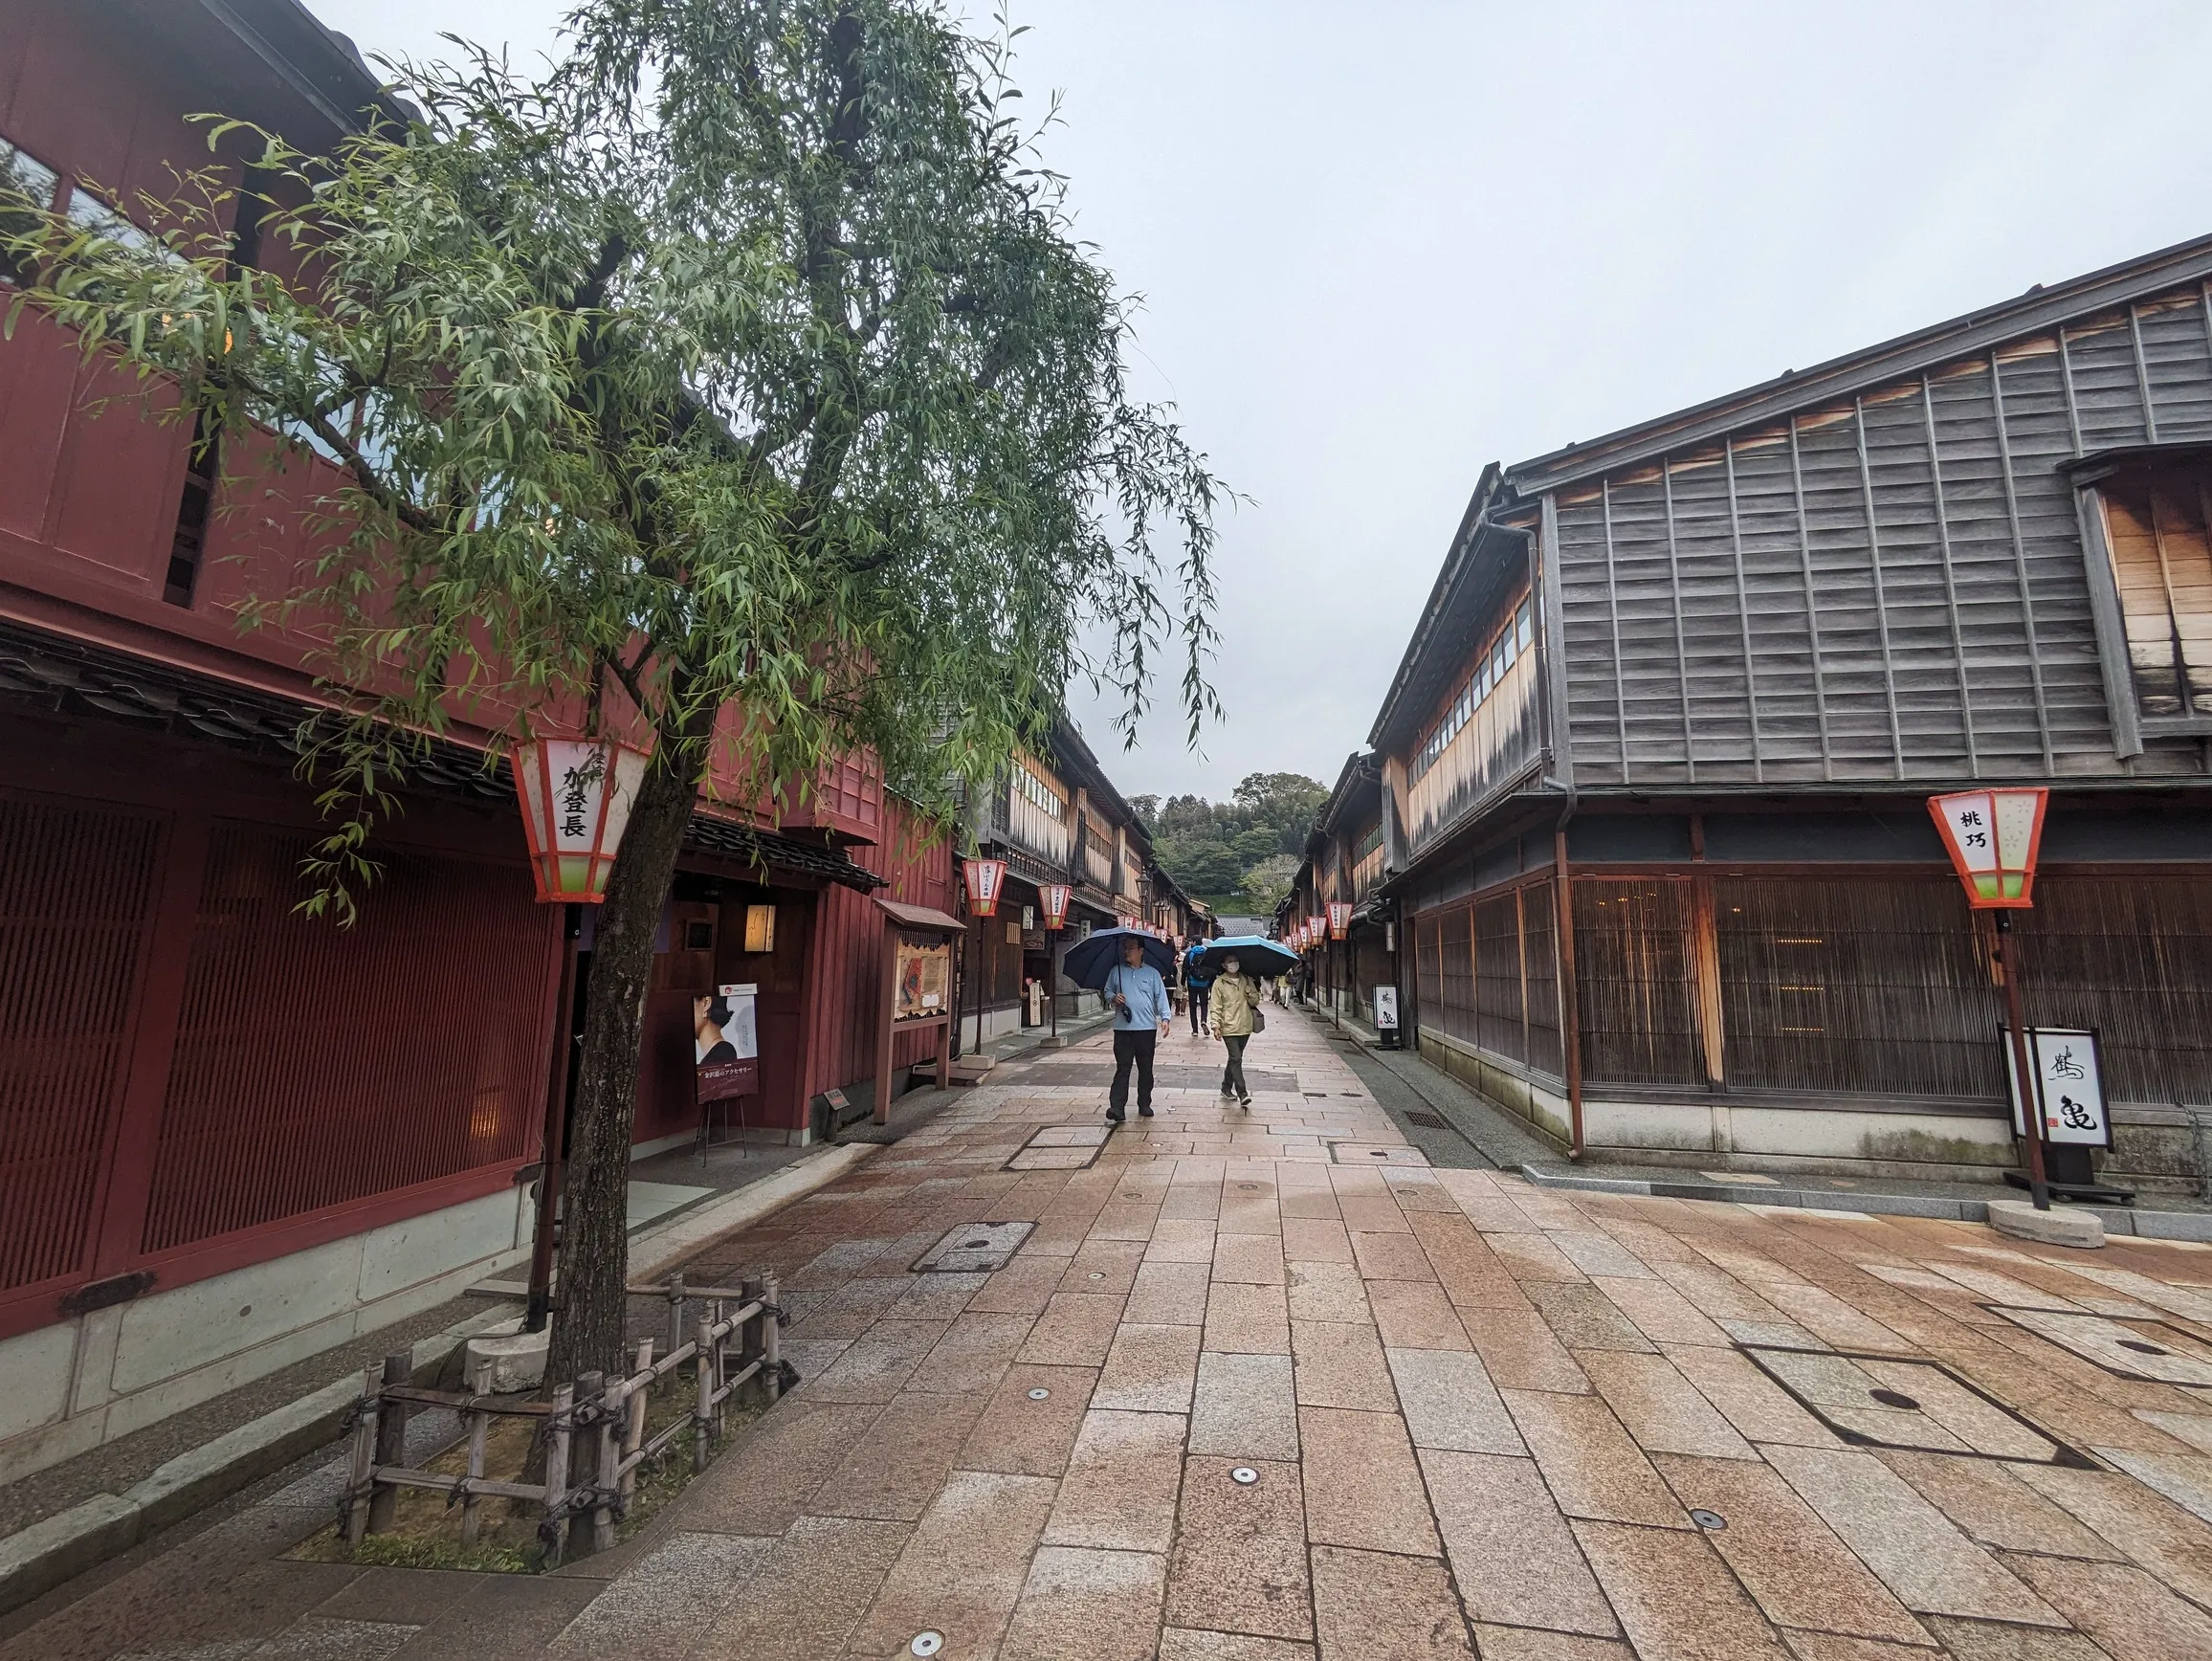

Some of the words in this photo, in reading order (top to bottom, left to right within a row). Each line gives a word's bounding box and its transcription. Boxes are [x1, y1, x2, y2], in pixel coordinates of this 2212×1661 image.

[1960, 810, 1987, 849] 桃巧
[1381, 990, 1396, 1025] 鶴亀
[2047, 1045, 2097, 1131] 鶴亀
